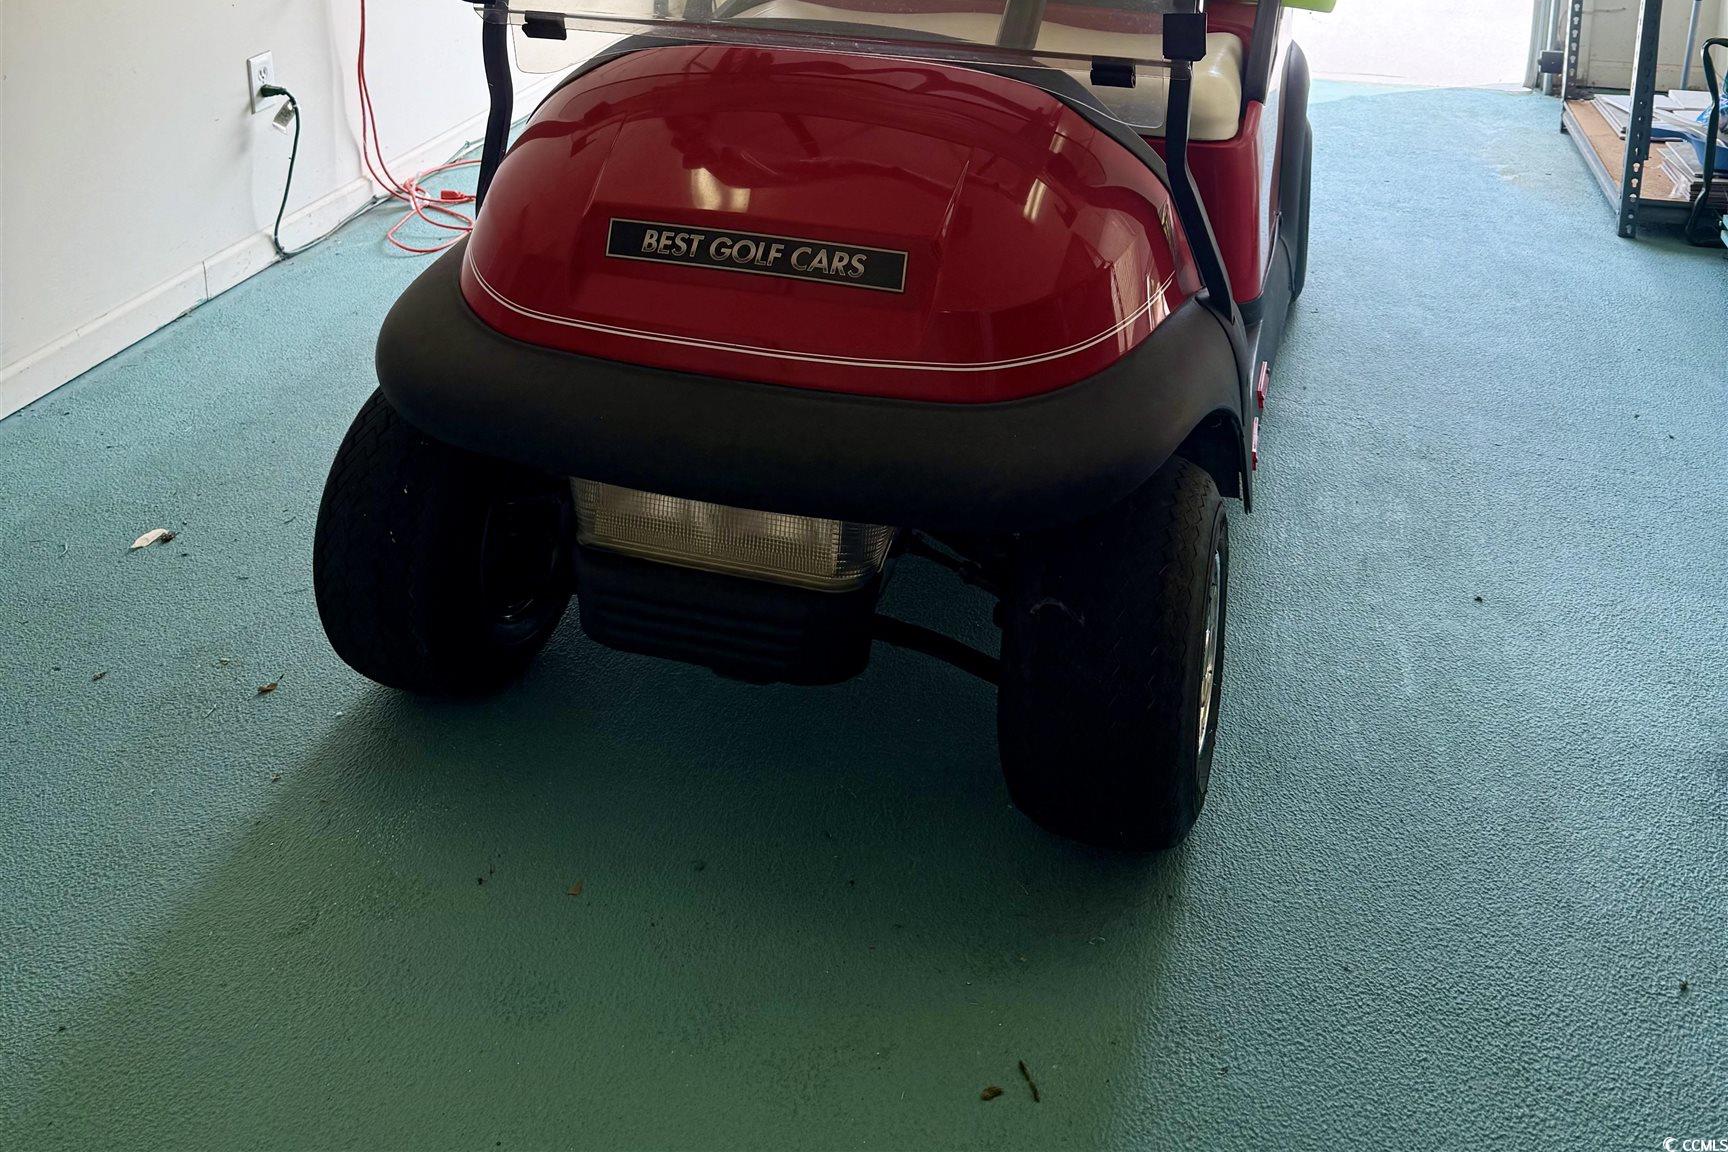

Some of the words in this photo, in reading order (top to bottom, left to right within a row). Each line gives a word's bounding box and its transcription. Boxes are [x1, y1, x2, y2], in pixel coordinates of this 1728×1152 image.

[641, 229, 705, 258] BEST
[709, 236, 786, 268] GOLF
[790, 247, 868, 279] CARS
